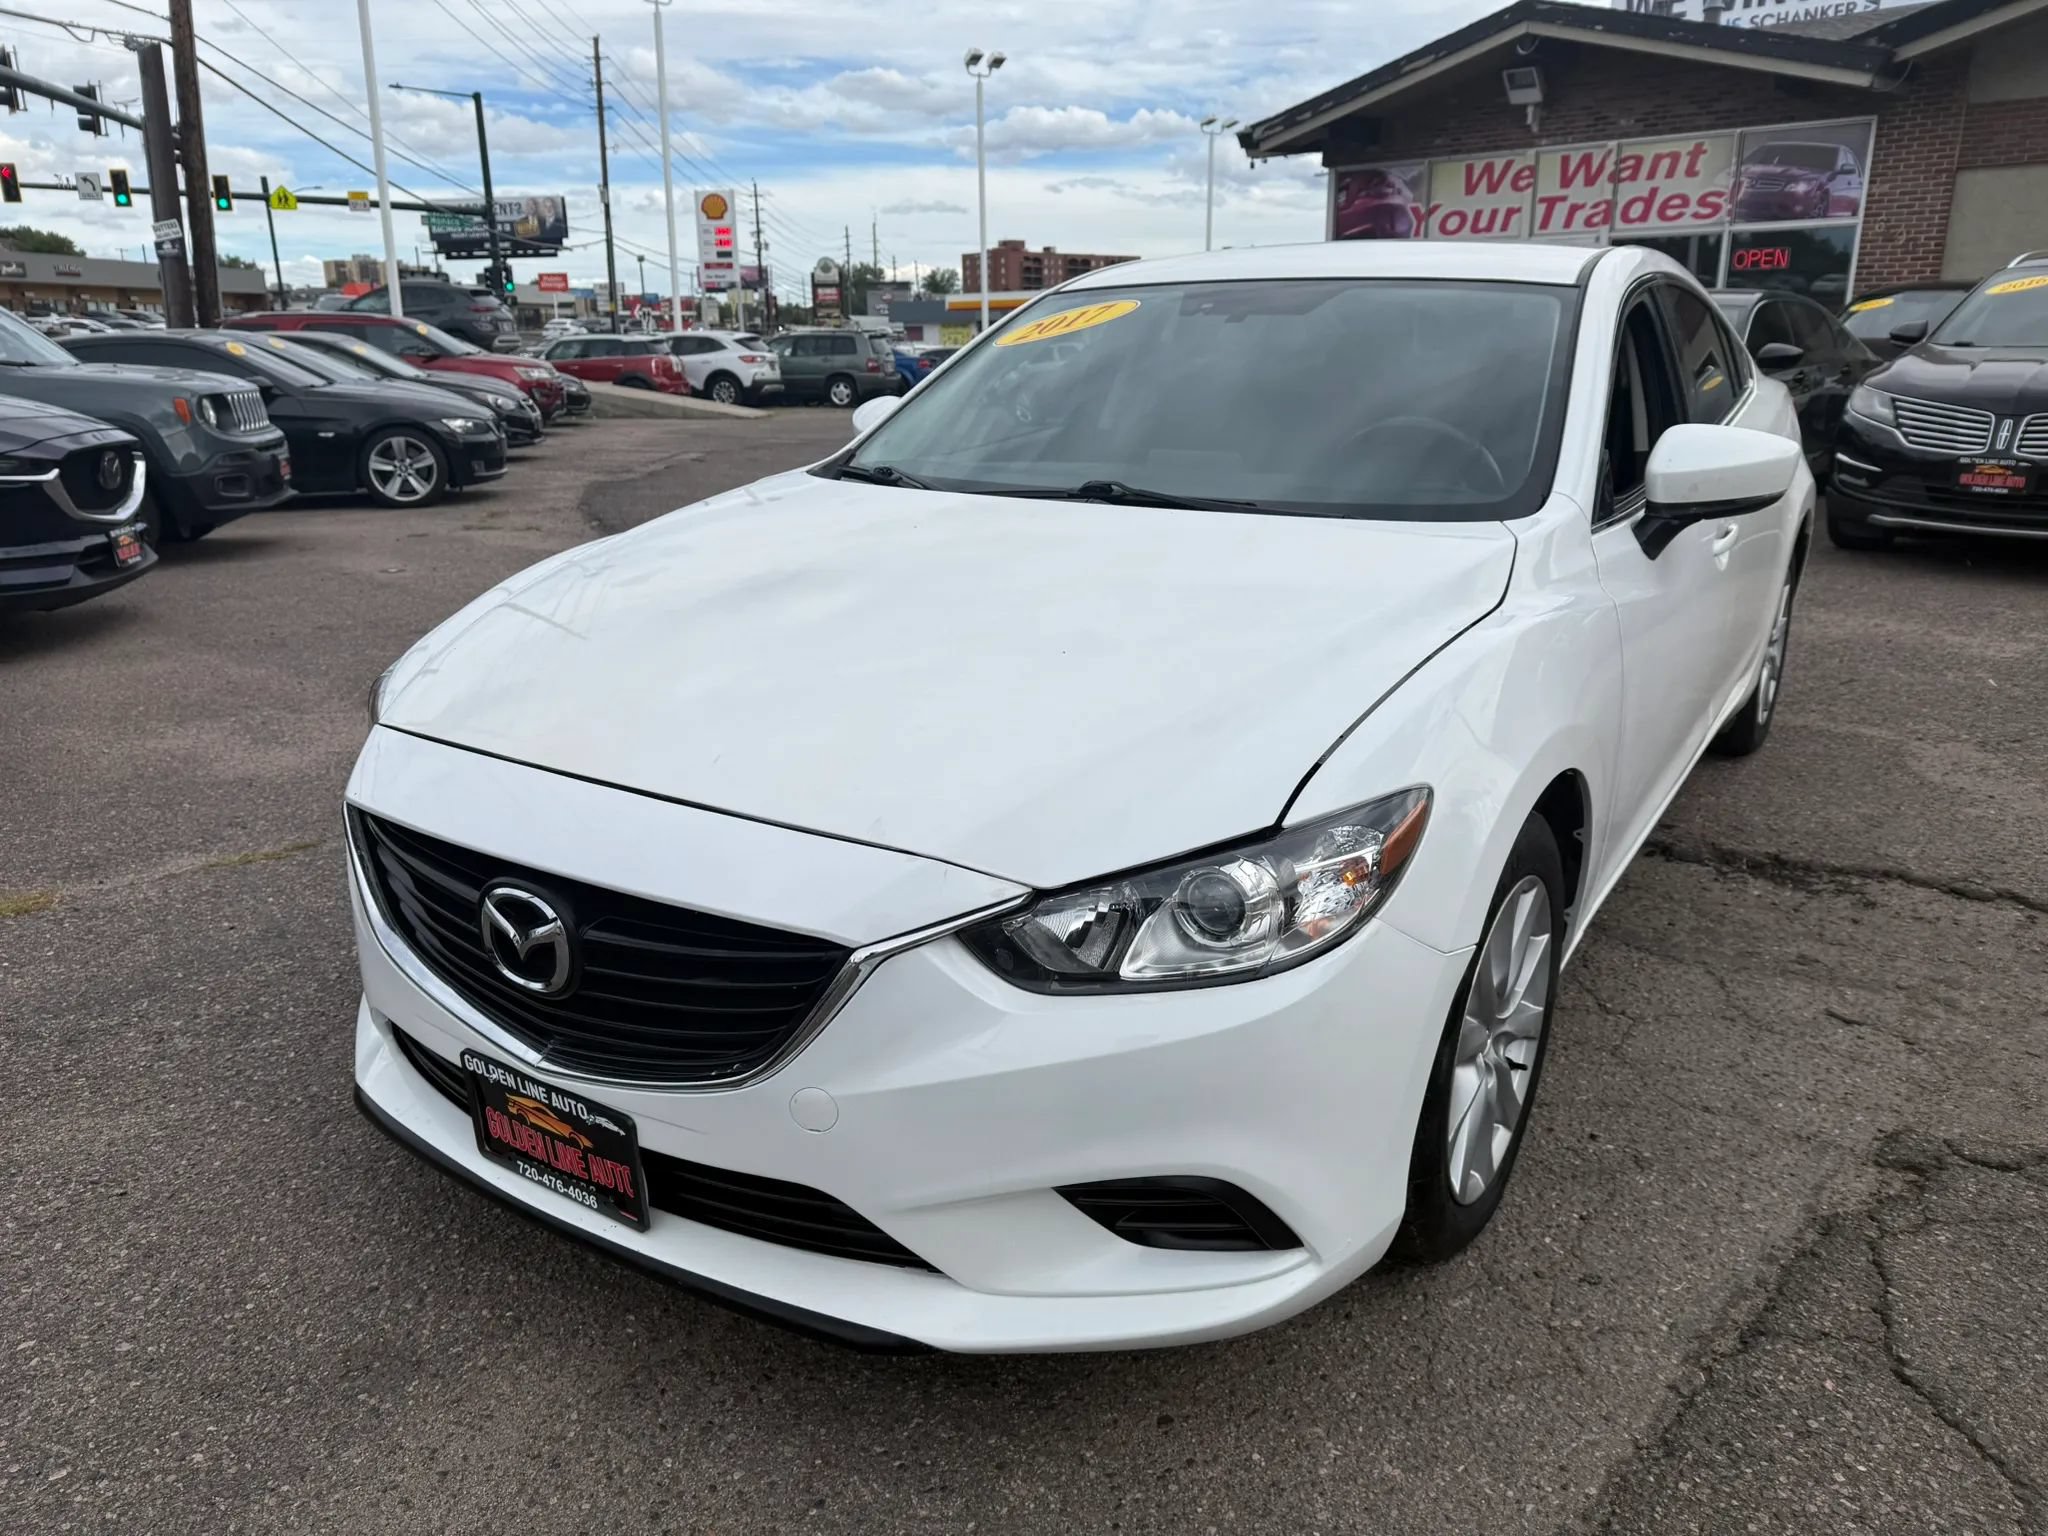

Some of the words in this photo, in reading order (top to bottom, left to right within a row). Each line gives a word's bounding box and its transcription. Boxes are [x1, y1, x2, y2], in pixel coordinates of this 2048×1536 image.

[1750, 1, 1858, 30] SCHANKER
[1464, 159, 1537, 197] We
[1559, 141, 1708, 190] Want
[1409, 202, 1522, 238] Your
[1733, 248, 1790, 270] OPEN
[1010, 302, 1119, 343] 2017
[463, 1053, 517, 1091] GOLDEN
[517, 1076, 549, 1104] LINE
[551, 1092, 588, 1120] AUTO
[485, 1105, 548, 1164] GOLDEN
[545, 1134, 589, 1180] LINE
[516, 1160, 599, 1209] 720-476-4036
